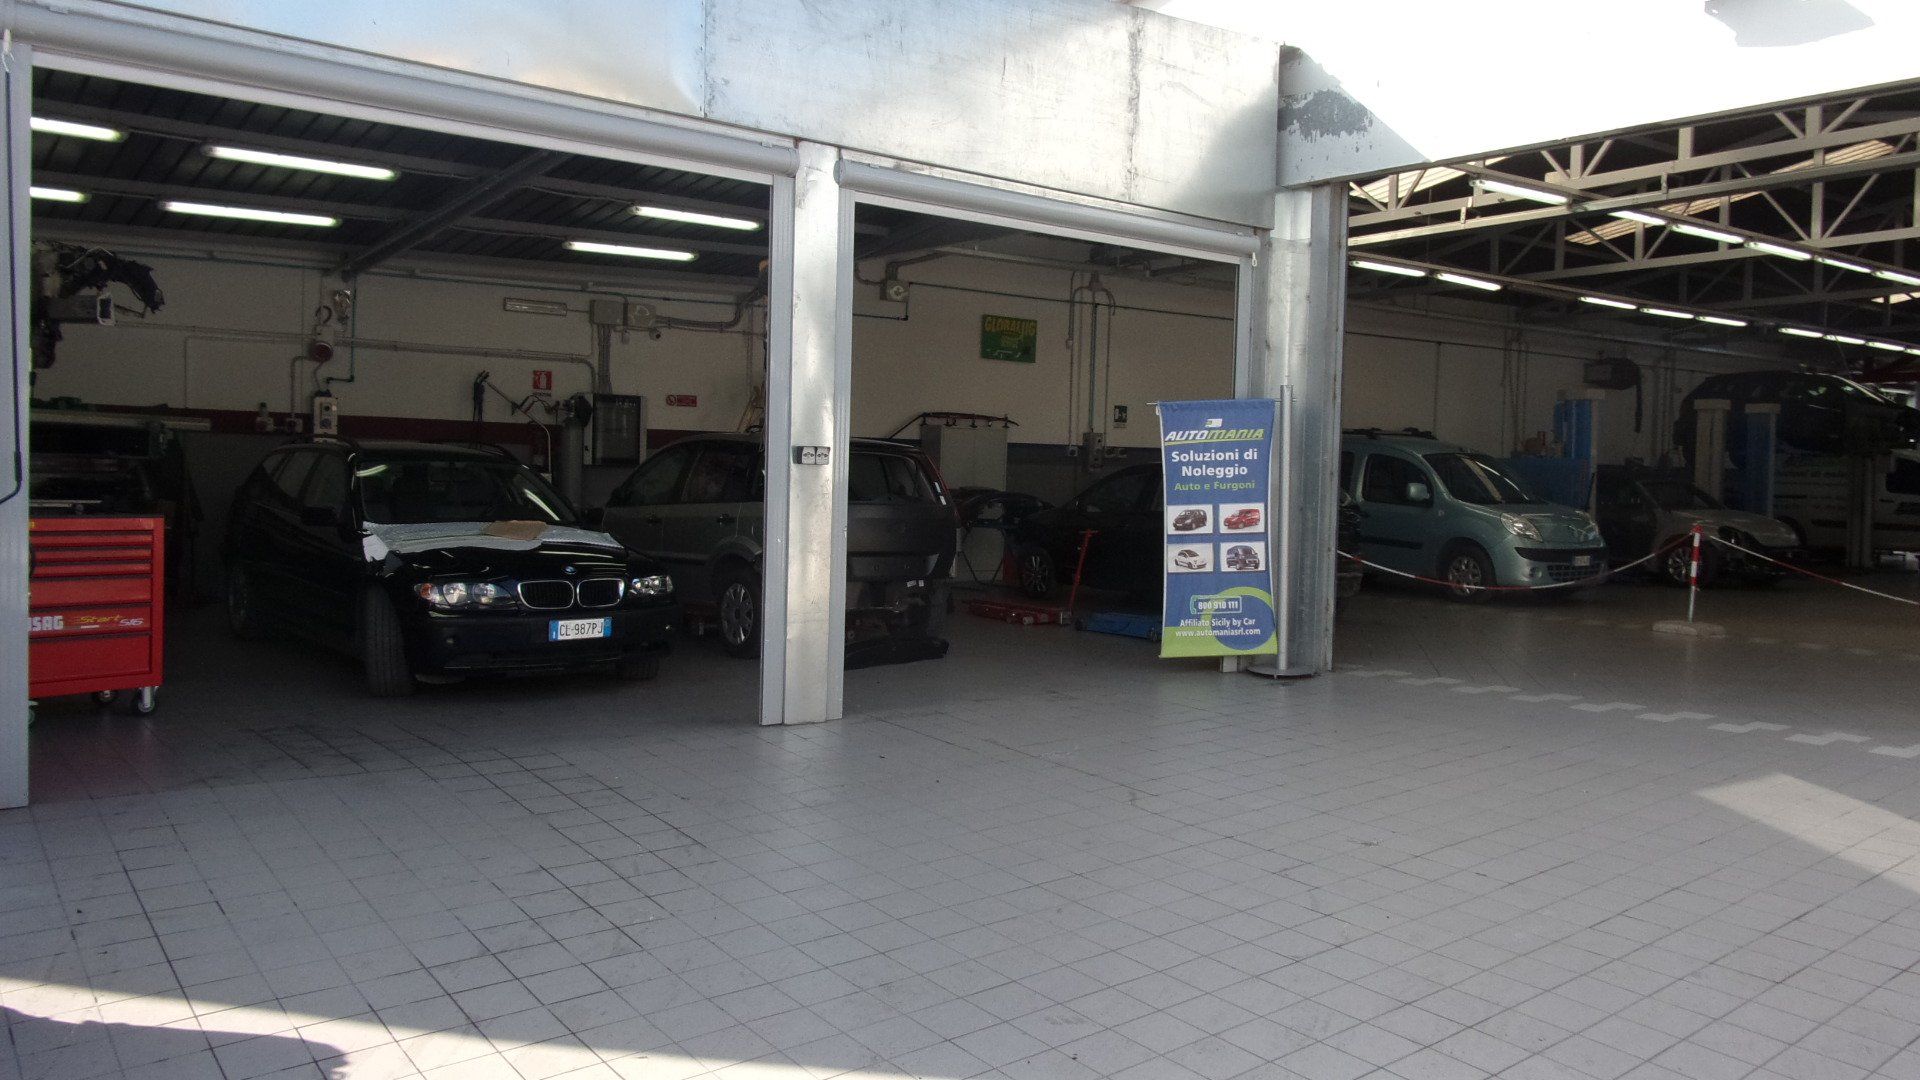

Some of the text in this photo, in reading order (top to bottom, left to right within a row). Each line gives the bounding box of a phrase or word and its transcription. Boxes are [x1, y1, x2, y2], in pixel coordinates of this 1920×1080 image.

[1171, 448, 1258, 462] Soluzioni di
[1181, 464, 1248, 478] Noleggio
[1175, 482, 1201, 491] Auto
[1213, 480, 1256, 491] Furgoni
[1197, 600, 1238, 610] 800 910 111
[80, 614, 121, 624] Start
[1180, 617, 1256, 628] Affiliato Sicily by Car
[1175, 627, 1261, 637] www.automaniasrl.com
